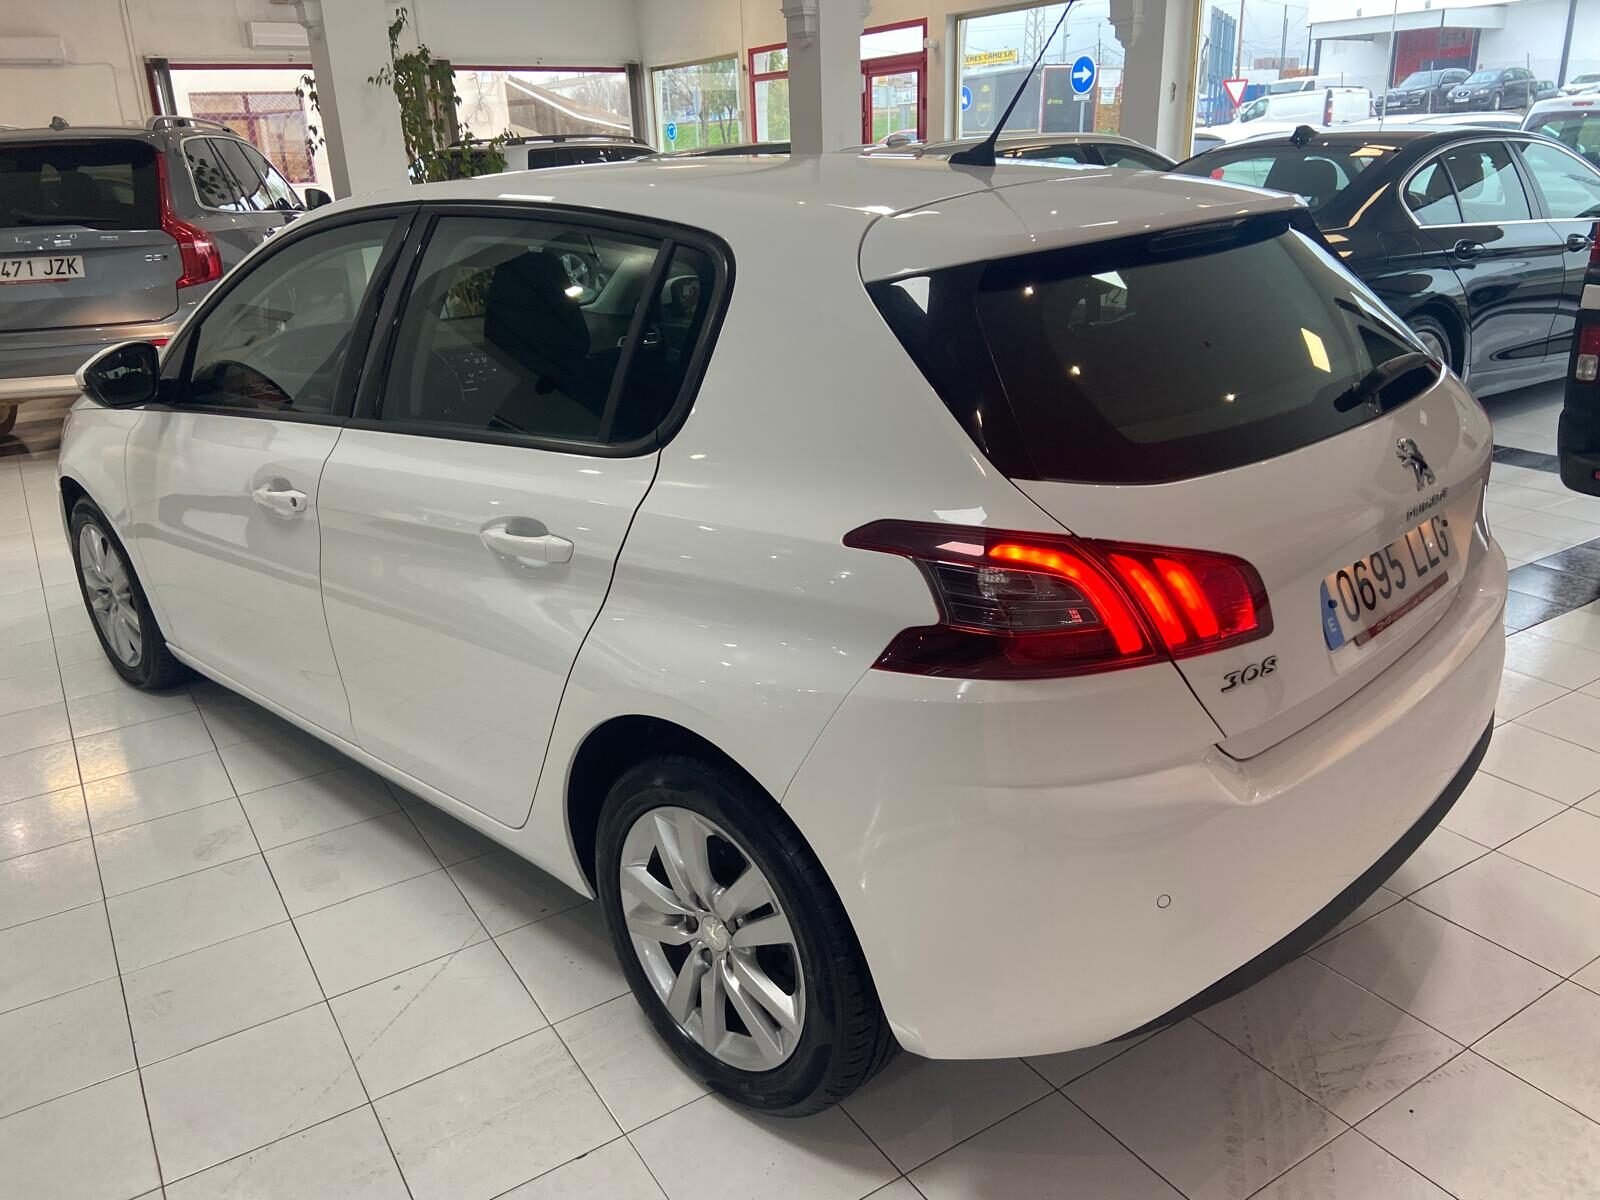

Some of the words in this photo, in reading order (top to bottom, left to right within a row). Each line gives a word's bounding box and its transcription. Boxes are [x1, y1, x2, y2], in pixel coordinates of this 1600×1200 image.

[1, 259, 34, 277] 471
[44, 258, 78, 276] JZK
[1336, 543, 1406, 622] 0695
[1405, 514, 1449, 578] LLG
[1220, 655, 1278, 693] 308
